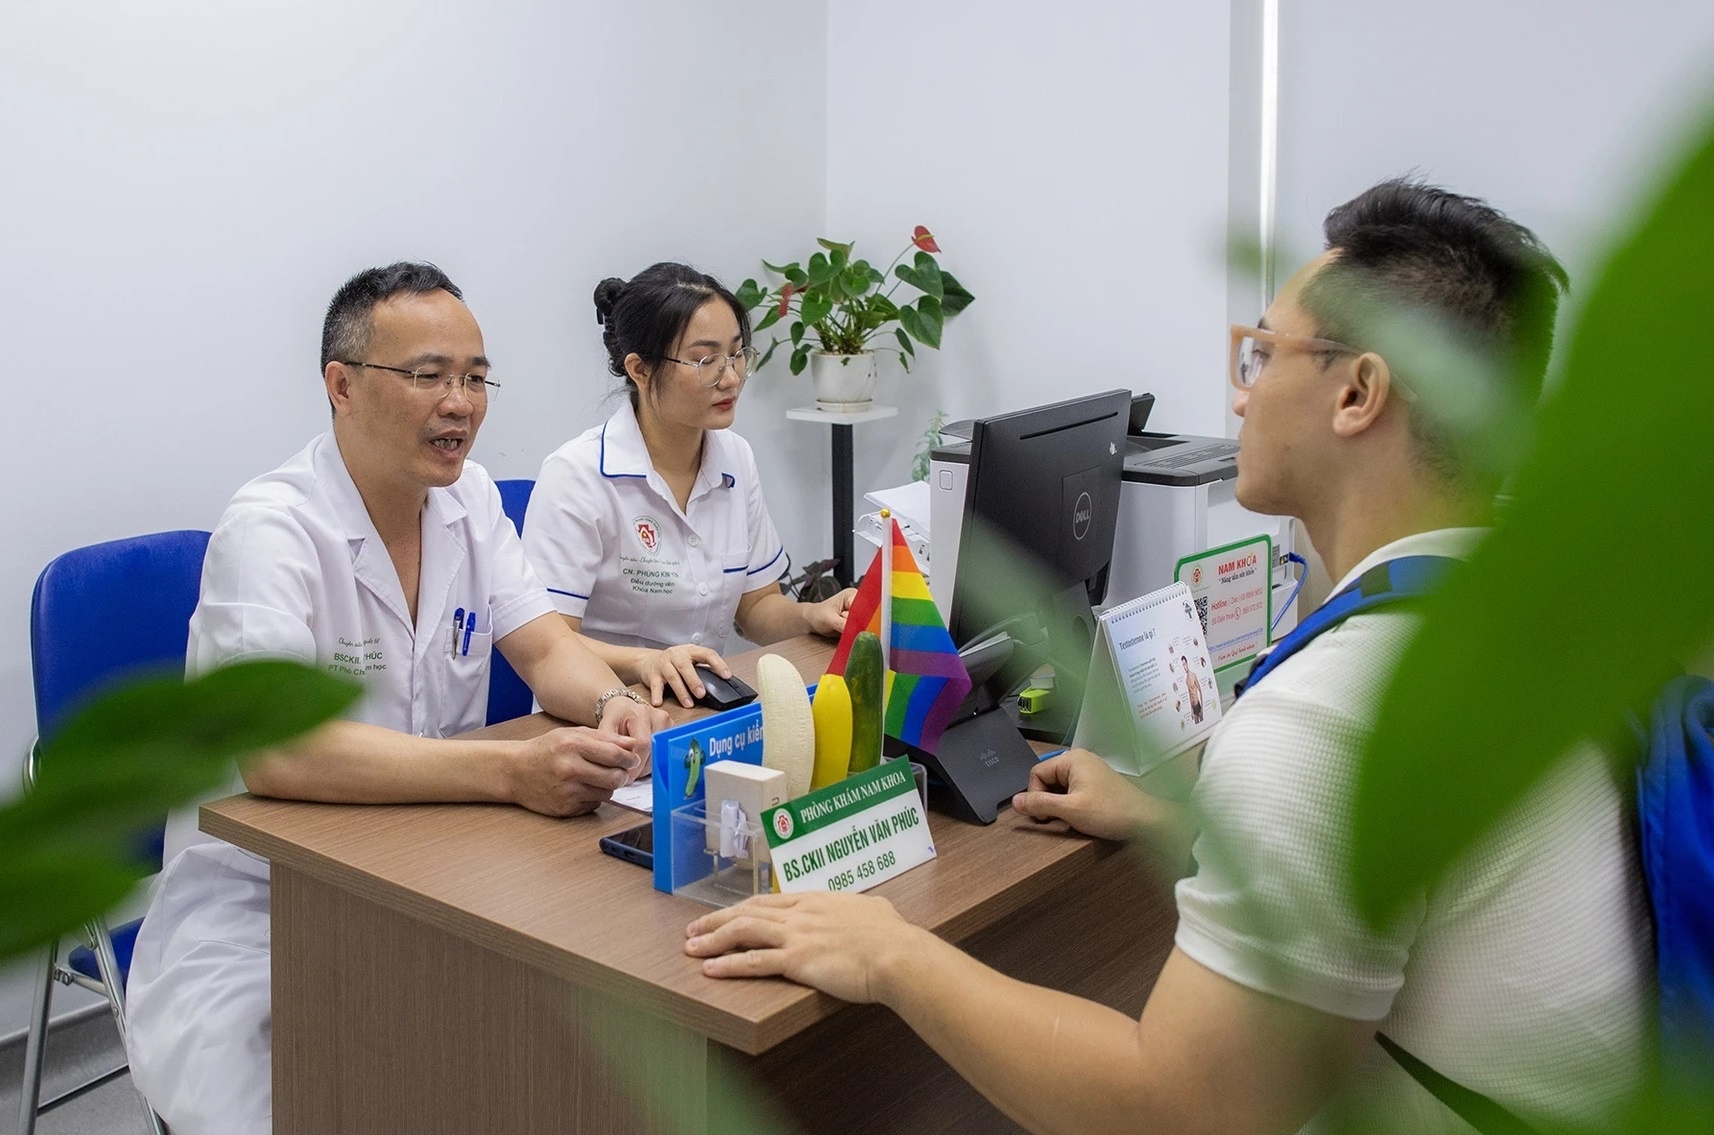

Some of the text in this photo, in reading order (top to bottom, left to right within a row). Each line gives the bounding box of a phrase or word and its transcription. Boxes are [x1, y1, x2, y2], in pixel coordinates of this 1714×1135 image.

[1075, 509, 1090, 524] DELL
[1218, 561, 1235, 575] NAM
[632, 585, 648, 593] Khoa
[364, 651, 383, 661] HÚC
[709, 737, 733, 758] Dụng
[735, 732, 745, 751] cụ
[800, 799, 833, 824] PHÒNG
[832, 787, 862, 815] KHÁM
[861, 779, 883, 800] NAM
[881, 770, 906, 791] KHOA
[783, 805, 919, 882] BS.CKII NGUYỄN VĂN PHÚC
[828, 851, 896, 892] 0985 458 688
